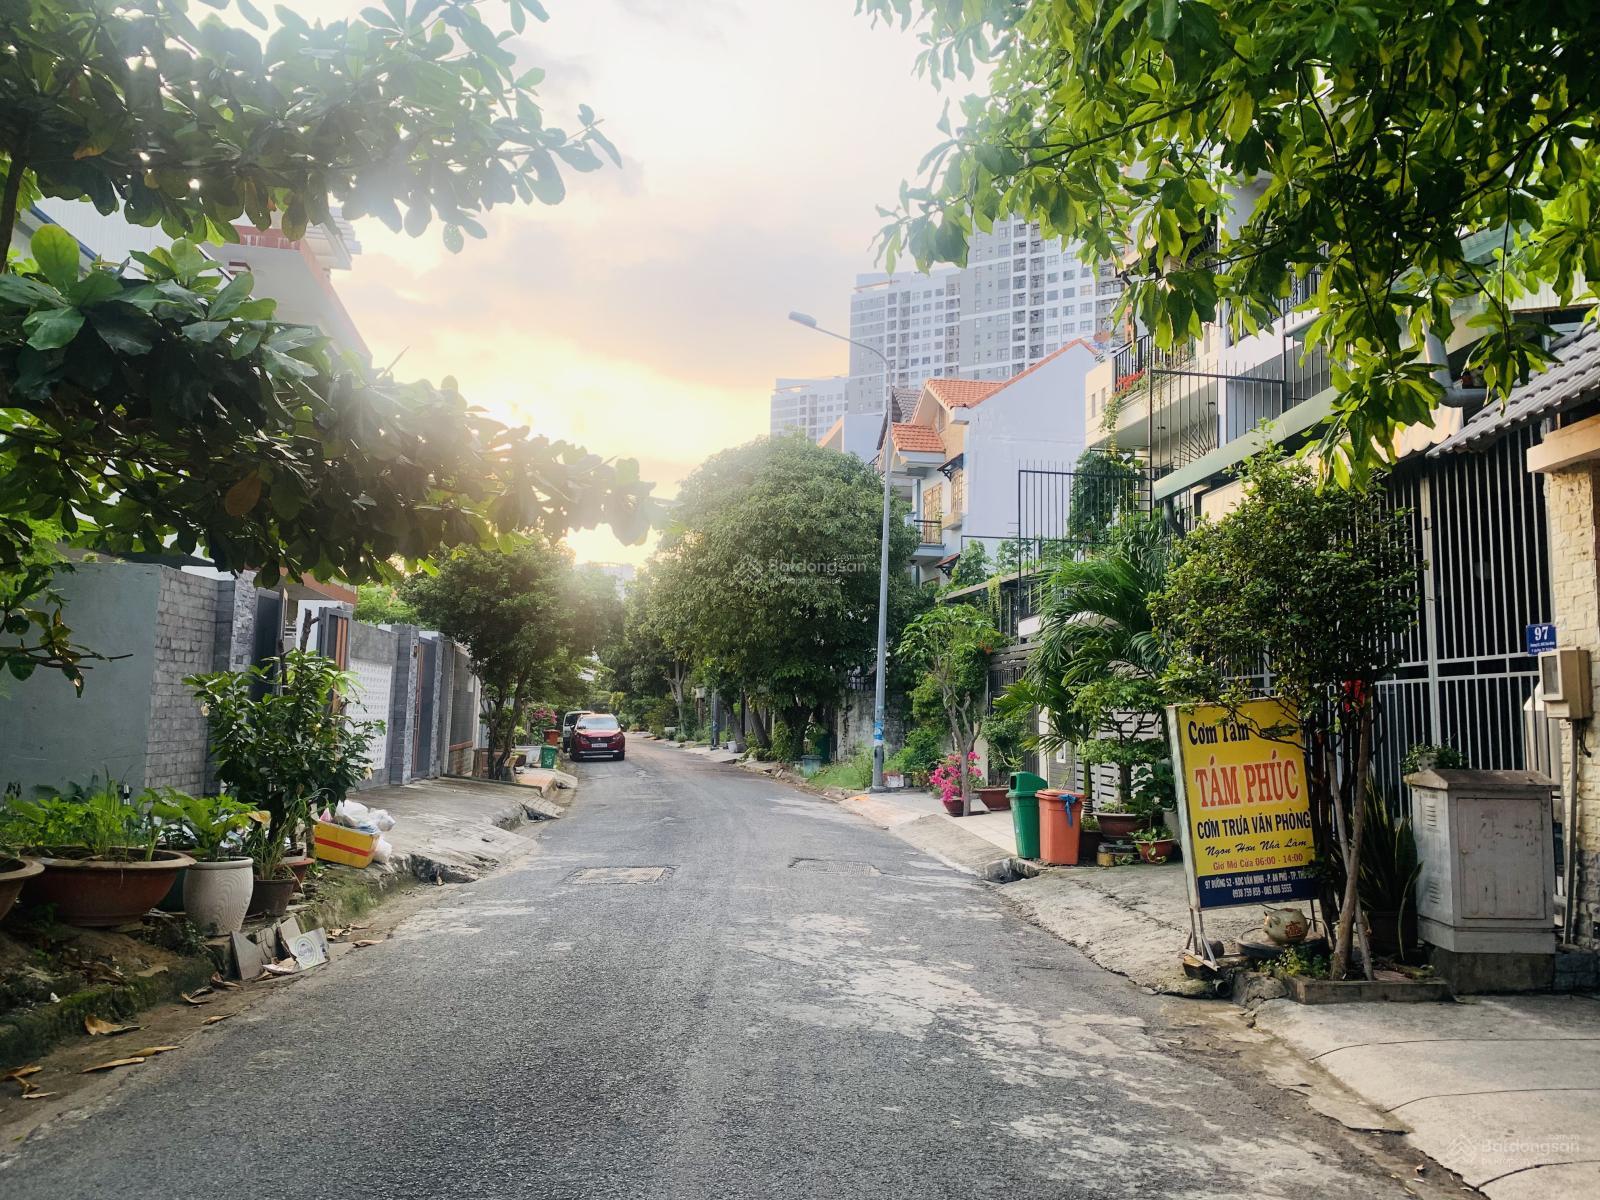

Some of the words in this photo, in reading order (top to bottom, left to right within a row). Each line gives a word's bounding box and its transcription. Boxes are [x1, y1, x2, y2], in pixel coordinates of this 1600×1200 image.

[1534, 626, 1548, 641] 97
[1188, 720, 1218, 746] Cơm
[1195, 755, 1241, 808] TÁM
[1243, 749, 1299, 803] PHÚC
[1197, 818, 1221, 840] CƠM
[1222, 814, 1250, 837] TRƯA
[1251, 812, 1273, 834] VĂN
[1275, 808, 1311, 831] PHÒNG
[1205, 846, 1231, 858] Ngon
[1255, 856, 1276, 866] 06:00
[1283, 853, 1304, 864] 14:00
[1205, 880, 1211, 889] 97
